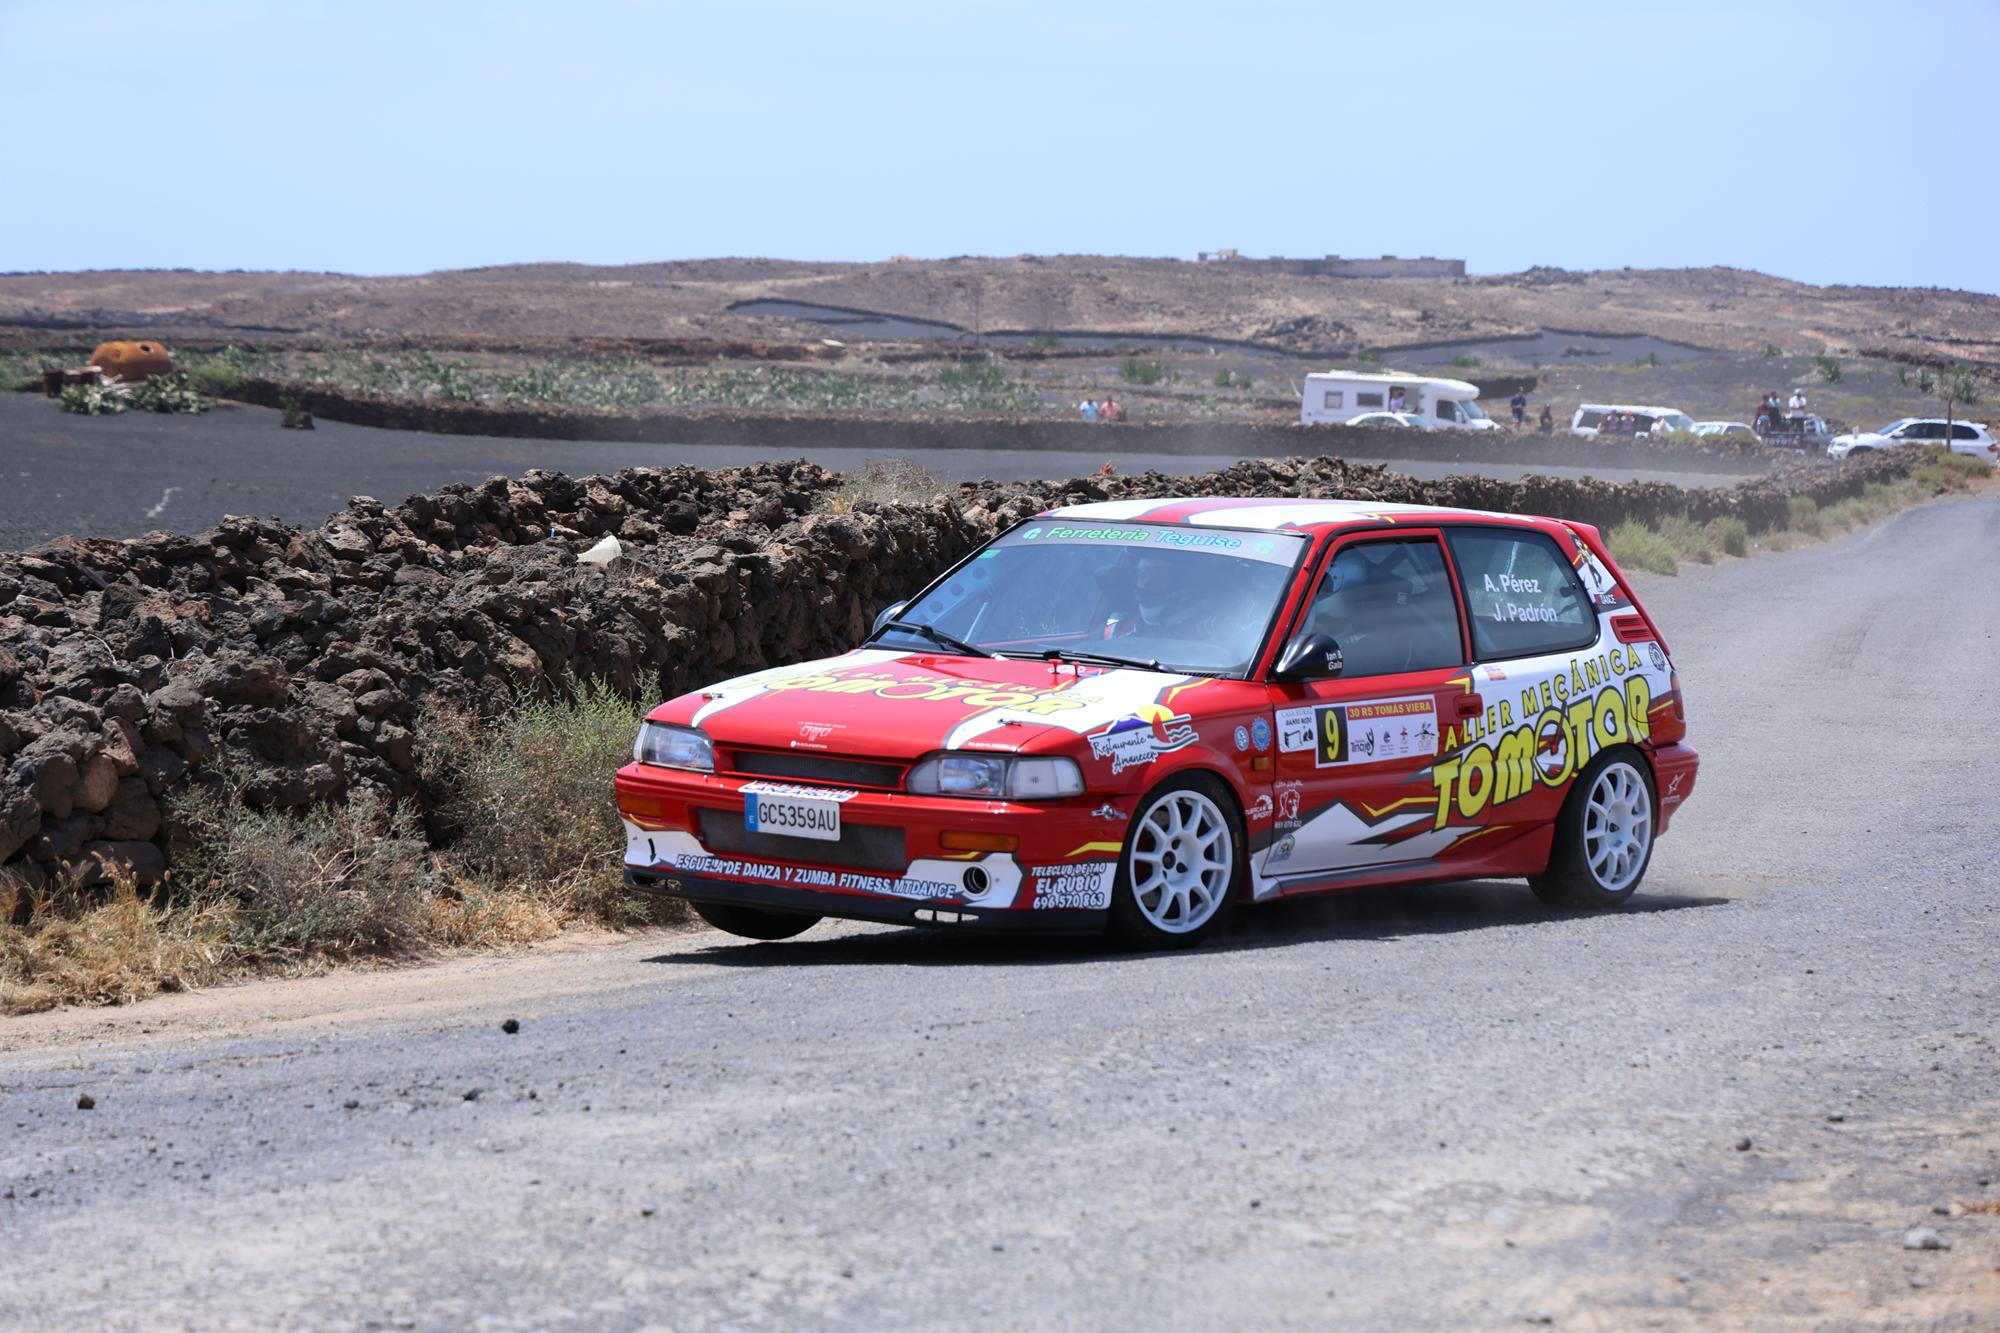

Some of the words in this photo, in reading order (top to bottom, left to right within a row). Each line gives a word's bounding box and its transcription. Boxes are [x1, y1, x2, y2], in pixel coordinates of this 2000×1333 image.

[1155, 529, 1242, 550] Teguise
[1484, 574, 1499, 593] A.
[1500, 574, 1541, 594] Pérez
[1493, 604, 1506, 622] J.
[1507, 603, 1557, 623] Padrón
[724, 675, 1087, 716] TOMOTOR
[1434, 699, 1514, 757] ALLER
[1521, 643, 1642, 719] MECÁNICA
[1348, 706, 1360, 718] 30
[1405, 701, 1432, 713] VIERA
[1092, 731, 1147, 757] Restaurante
[1325, 709, 1340, 760] 9
[1431, 673, 1651, 832] TOMOTOR
[748, 815, 755, 824] E
[758, 802, 837, 832] GC5359AU
[675, 854, 724, 874] ESCUELA
[725, 860, 741, 876] DE
[743, 862, 781, 881] DANZA
[784, 866, 795, 881] Y
[794, 868, 837, 887] ZUMBA
[838, 873, 891, 893] FITNESS
[892, 878, 957, 898] MTDANCE
[1031, 864, 1074, 877] TELECLUB
[1075, 863, 1087, 875] DE
[1089, 862, 1107, 874] TAO
[1036, 877, 1054, 895] EL
[1056, 874, 1101, 893] RUBIO
[1033, 895, 1056, 910] 696
[1058, 894, 1080, 909] 570
[1082, 891, 1105, 907] 863
